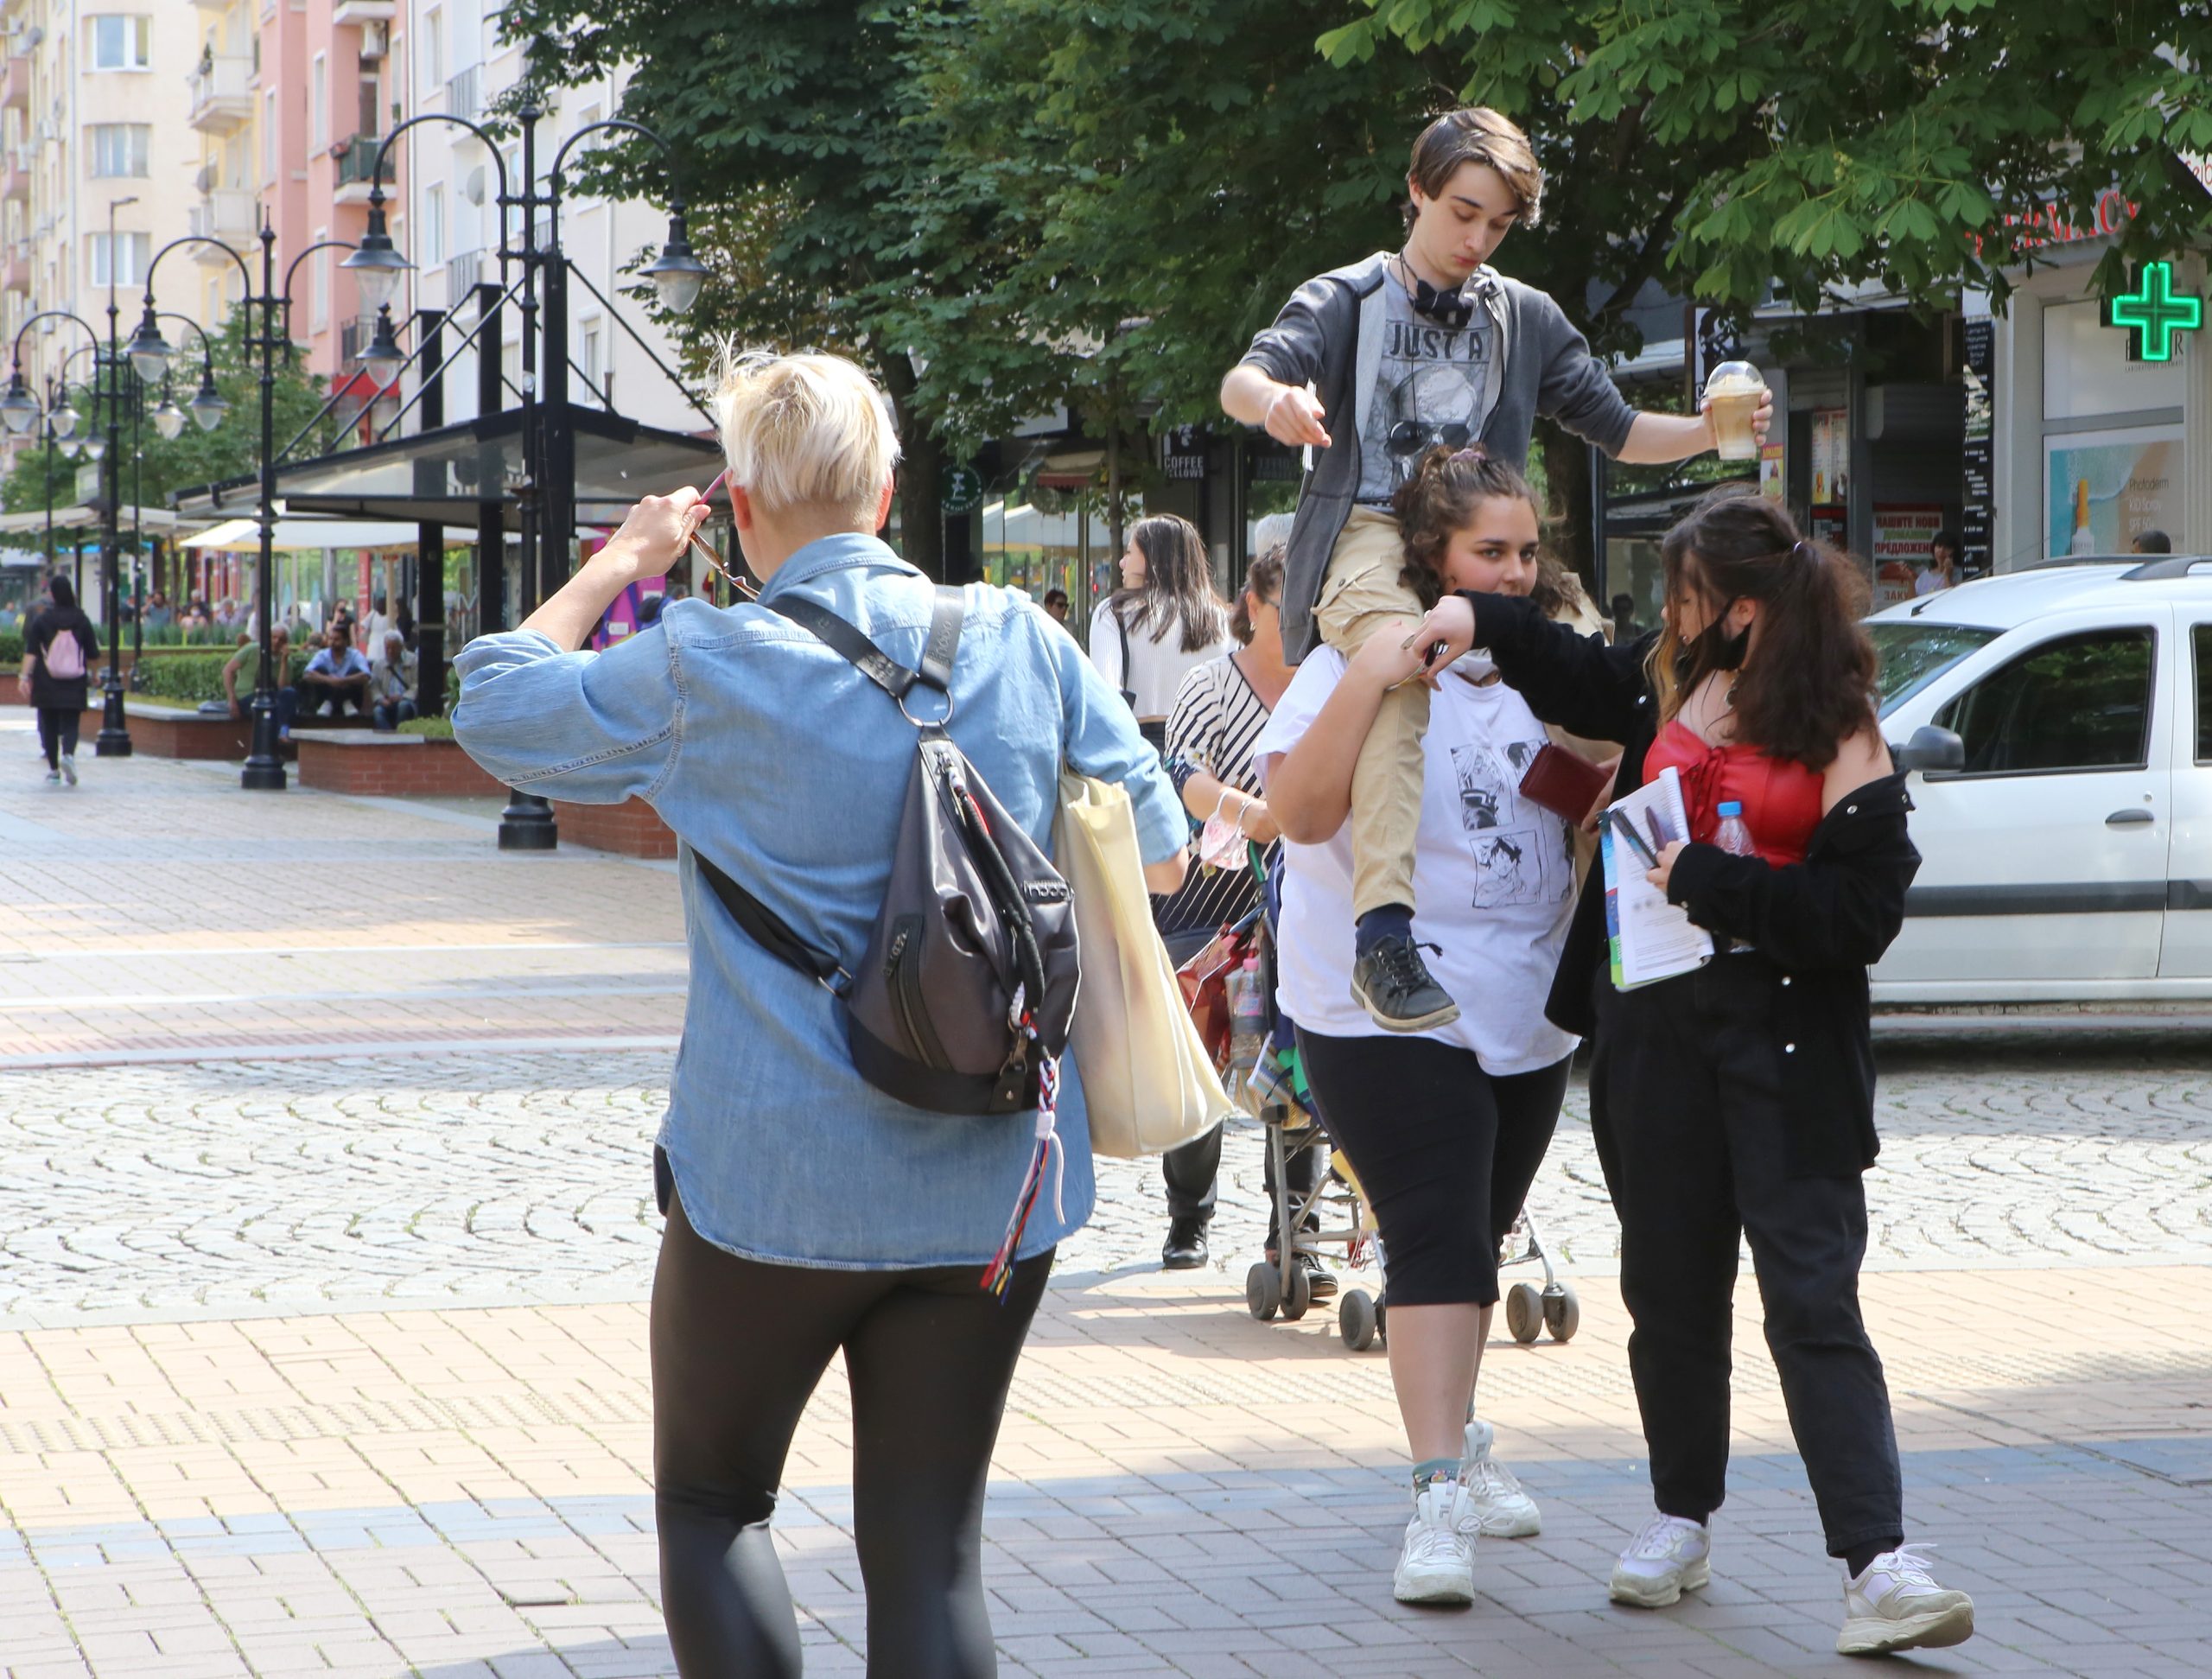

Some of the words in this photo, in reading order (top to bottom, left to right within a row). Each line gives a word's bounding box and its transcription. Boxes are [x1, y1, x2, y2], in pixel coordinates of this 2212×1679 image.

[1390, 324, 1459, 359] JUST
[1469, 332, 1483, 359] A
[1164, 455, 1204, 468] COFFEE
[1874, 542, 1934, 556] ПРЕДЛОЖЕН
